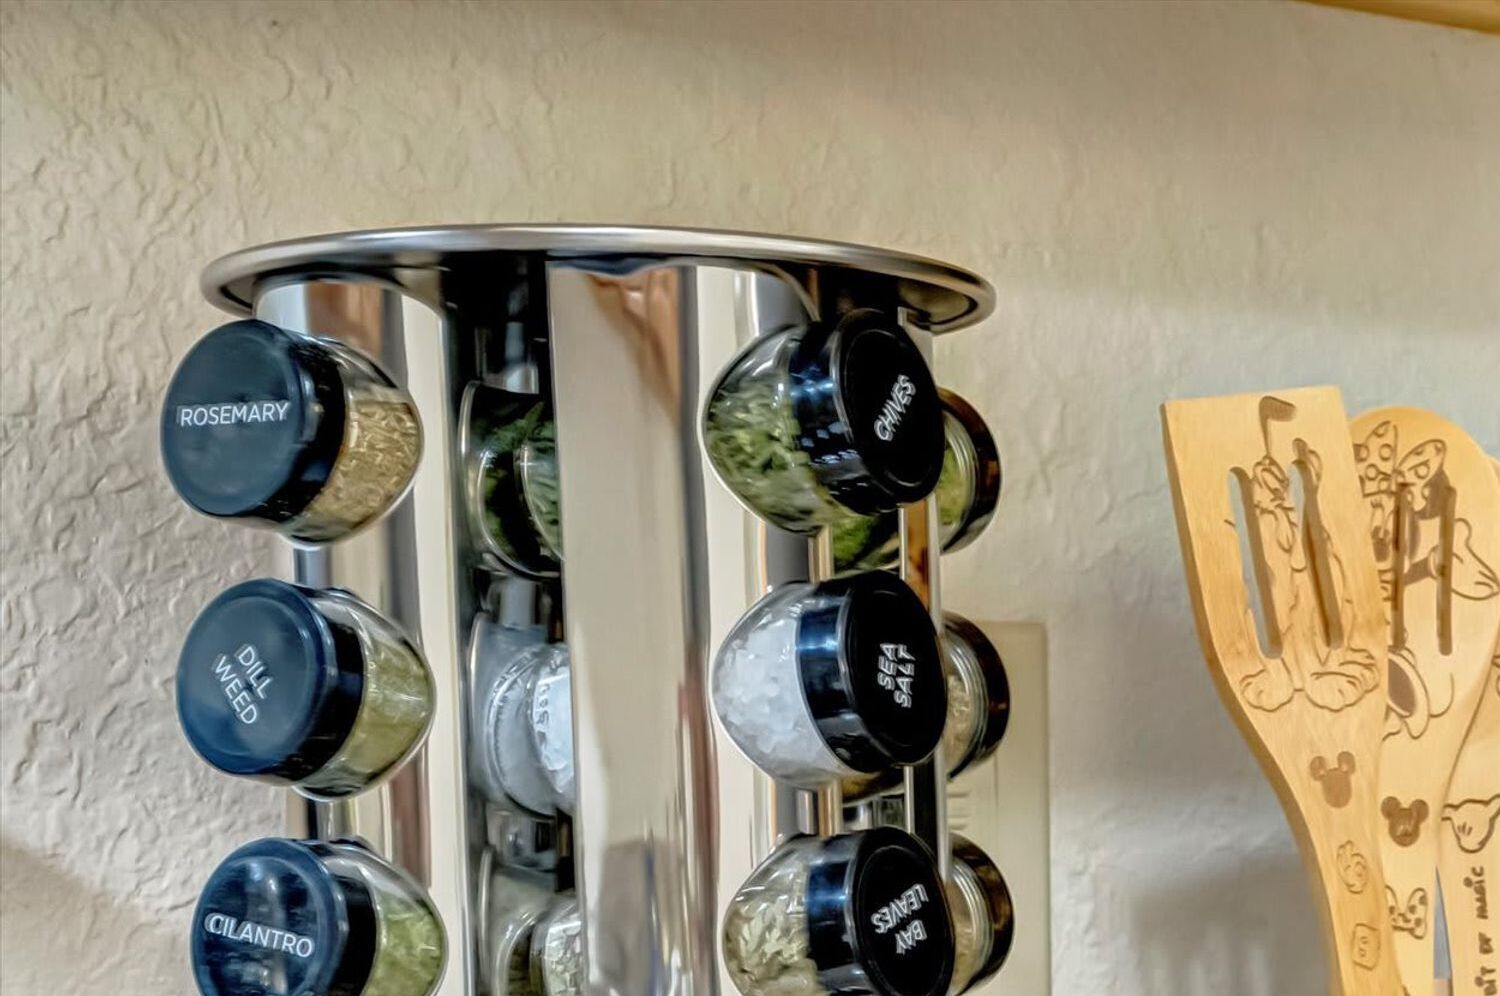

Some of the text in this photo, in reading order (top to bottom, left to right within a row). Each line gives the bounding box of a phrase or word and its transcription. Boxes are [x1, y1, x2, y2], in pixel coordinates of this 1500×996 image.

[177, 401, 290, 427] ROSEMARY
[874, 374, 916, 441] CHIVES
[213, 653, 258, 726] WEED
[236, 645, 274, 700] DILL
[877, 643, 897, 690] SEA
[894, 644, 916, 708] SALT
[870, 883, 929, 934] LEAVES
[206, 913, 314, 958] CILANTRO
[895, 919, 927, 955] BAY
